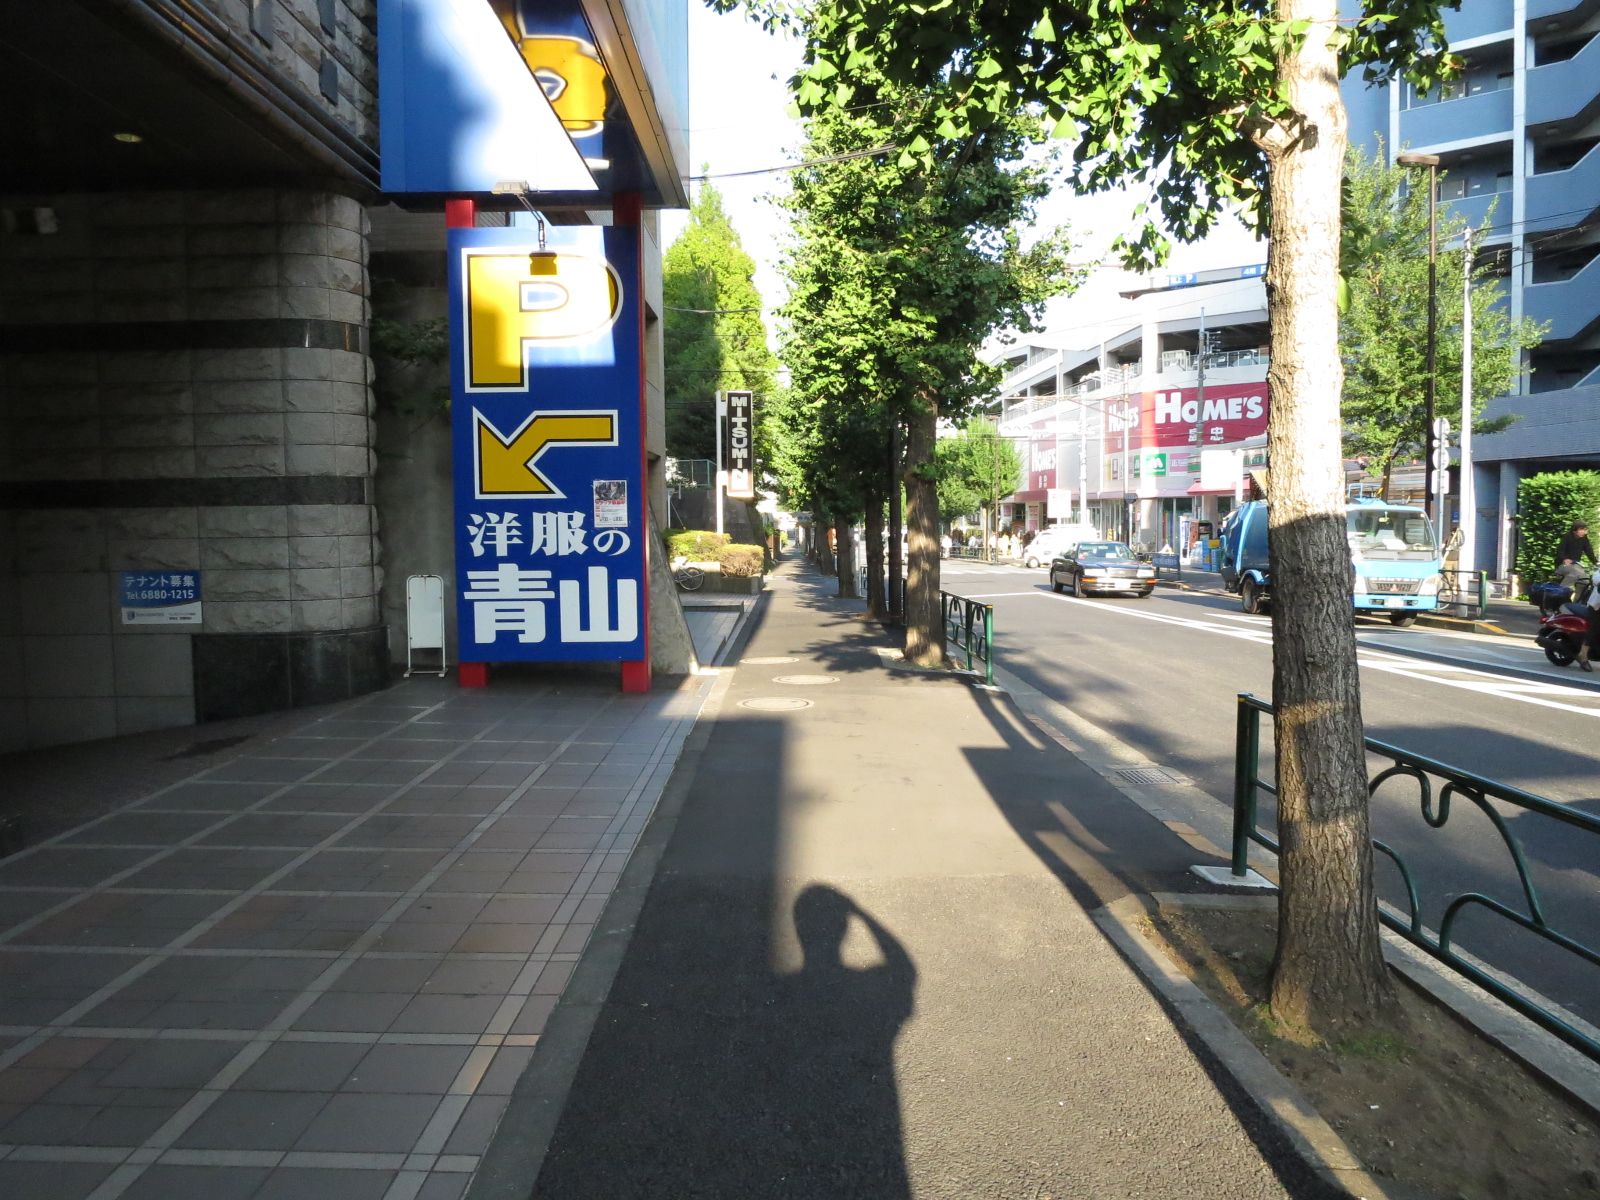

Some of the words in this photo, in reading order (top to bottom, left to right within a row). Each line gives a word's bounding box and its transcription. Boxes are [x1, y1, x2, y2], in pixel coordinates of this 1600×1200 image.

[461, 247, 624, 393] P
[466, 511, 631, 557] 洋服の
[125, 575, 195, 587] テナント募集
[463, 563, 638, 644] 青山
